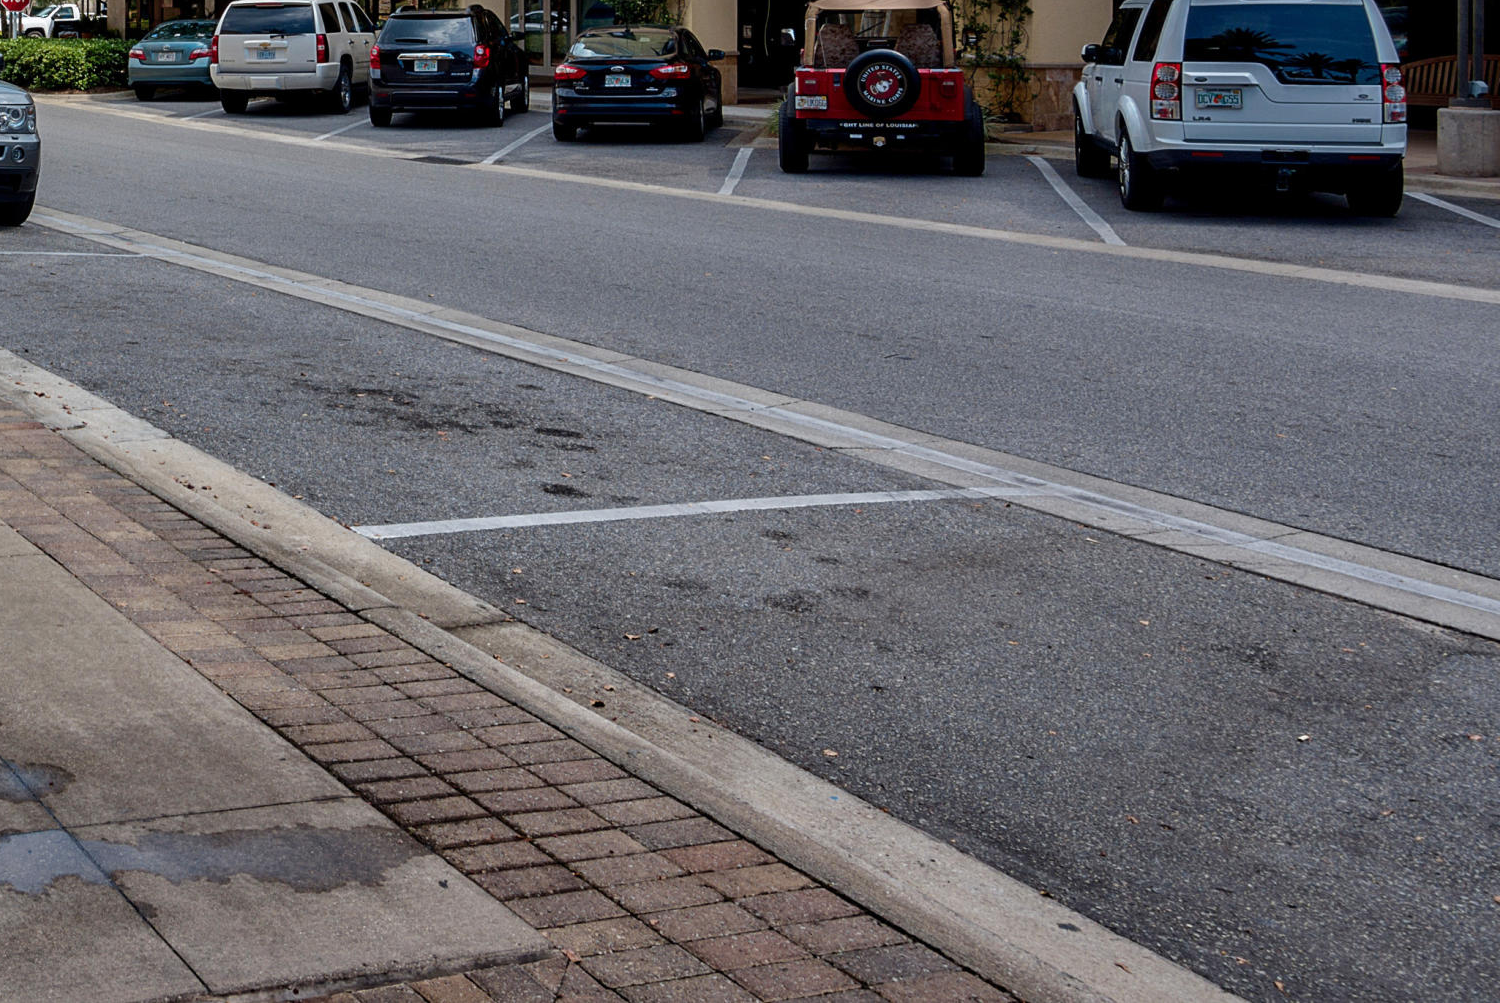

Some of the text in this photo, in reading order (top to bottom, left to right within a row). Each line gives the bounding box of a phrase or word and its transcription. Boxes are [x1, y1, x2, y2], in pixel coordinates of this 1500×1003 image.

[860, 65, 903, 83] UNITED STATES
[863, 90, 886, 104] MARINE
